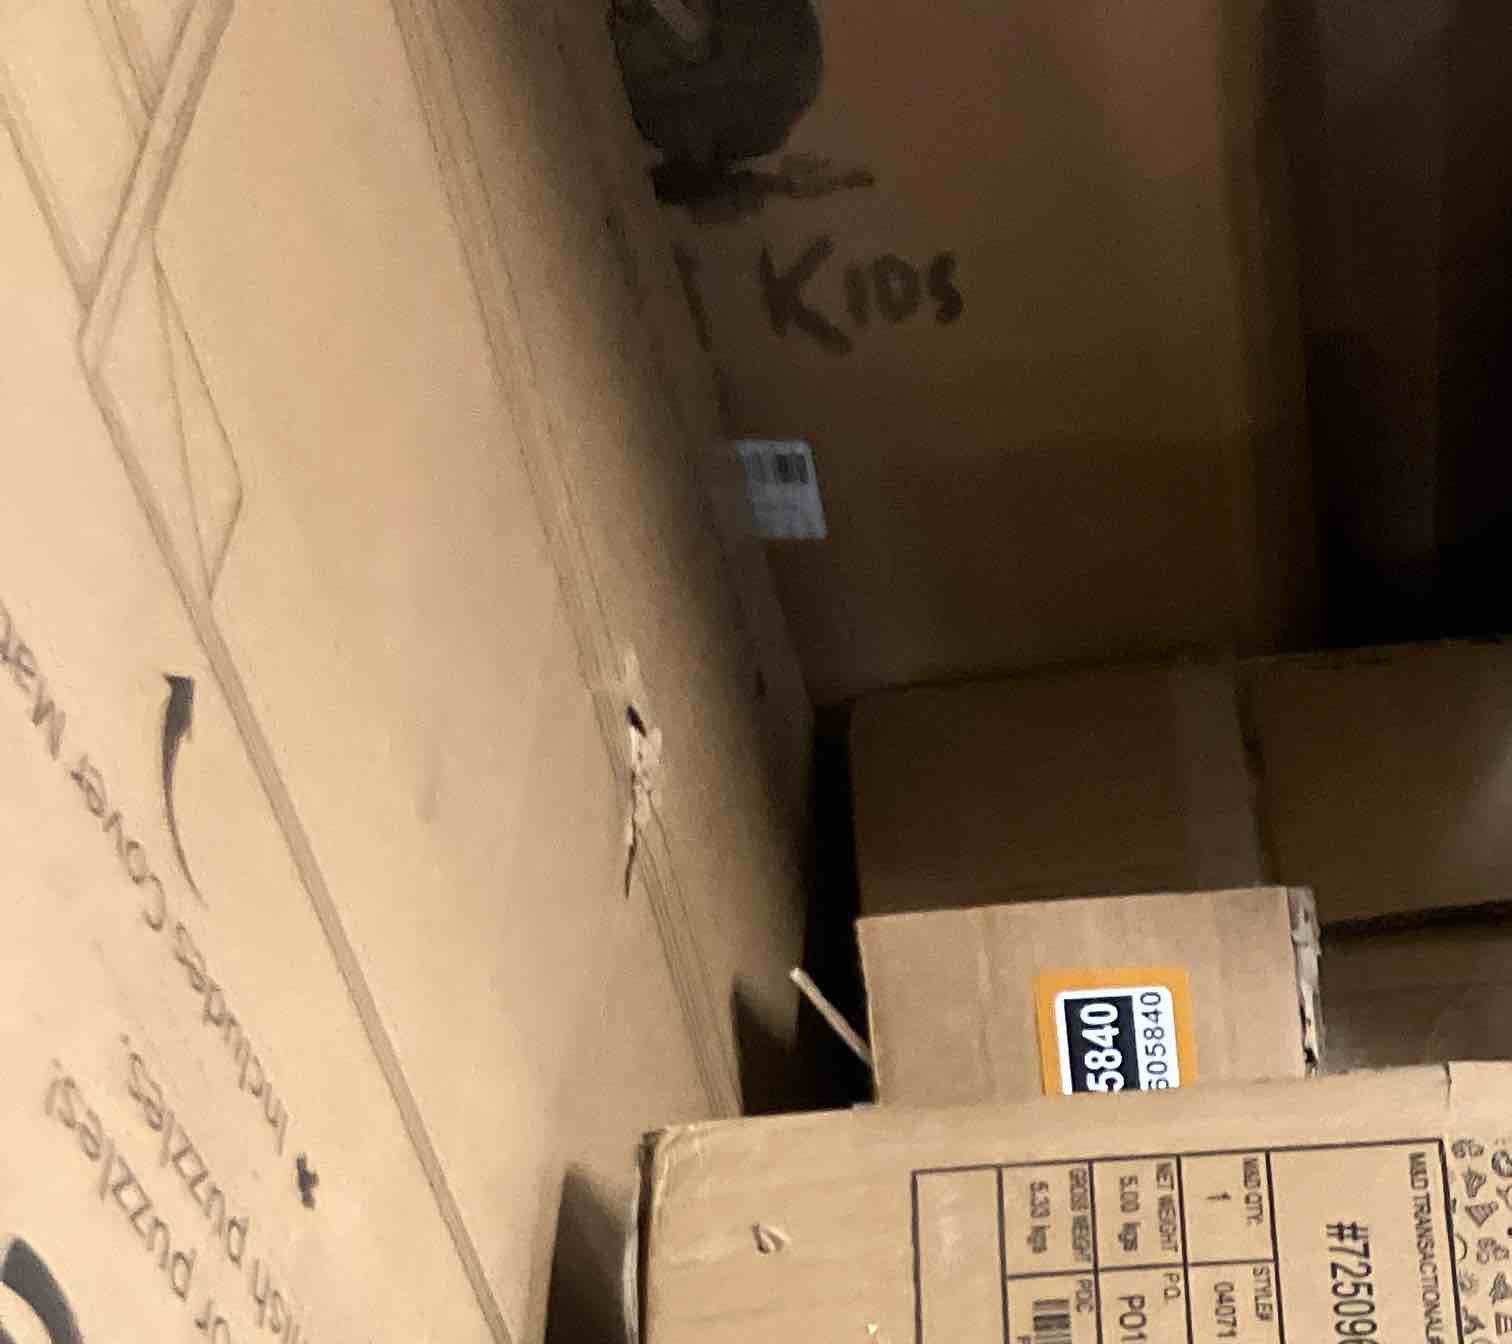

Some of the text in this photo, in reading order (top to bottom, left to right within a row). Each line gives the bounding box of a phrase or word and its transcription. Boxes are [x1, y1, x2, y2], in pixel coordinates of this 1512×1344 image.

[69, 755, 167, 933] Cover
[175, 921, 288, 1157] Includes
[1079, 1003, 1126, 1093] 5840
[1155, 1161, 1179, 1254] NET WEIGHT
[1206, 1190, 1232, 1202] 1
[1212, 1281, 1238, 1340] 04071
